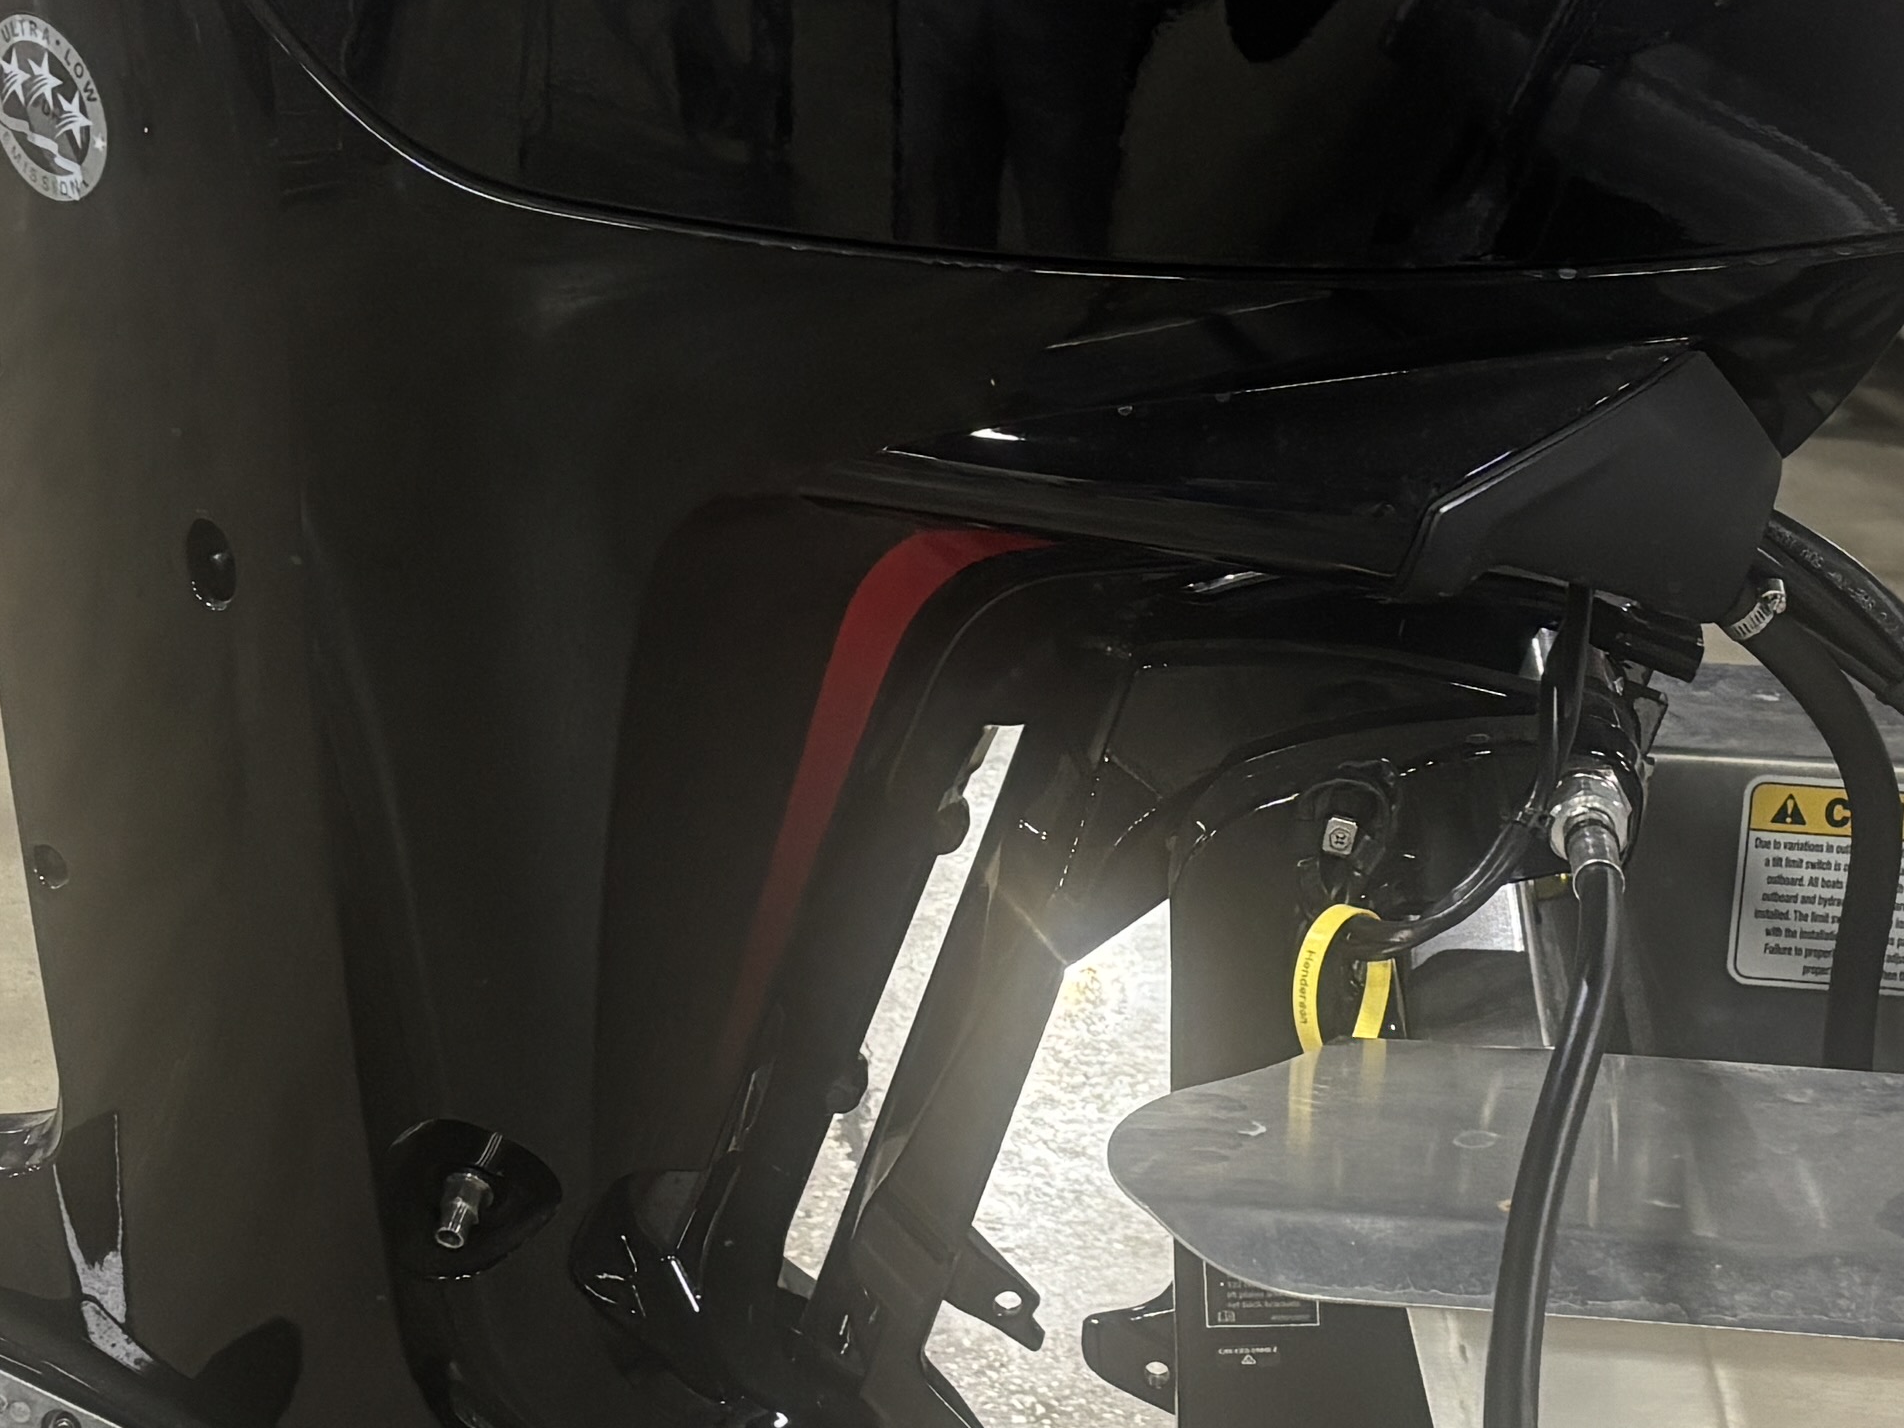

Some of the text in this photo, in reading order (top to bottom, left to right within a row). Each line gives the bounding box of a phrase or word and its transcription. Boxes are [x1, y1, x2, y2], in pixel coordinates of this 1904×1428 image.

[0, 19, 98, 103] ULTRA LOW
[1773, 838, 1782, 850] to
[1783, 839, 1824, 853] variations
[1826, 841, 1835, 853] in
[1805, 859, 1832, 871] switch
[1821, 876, 1844, 889] boats
[1800, 893, 1816, 905] and
[1794, 910, 1809, 922] The
[1764, 942, 1792, 956] Failure
